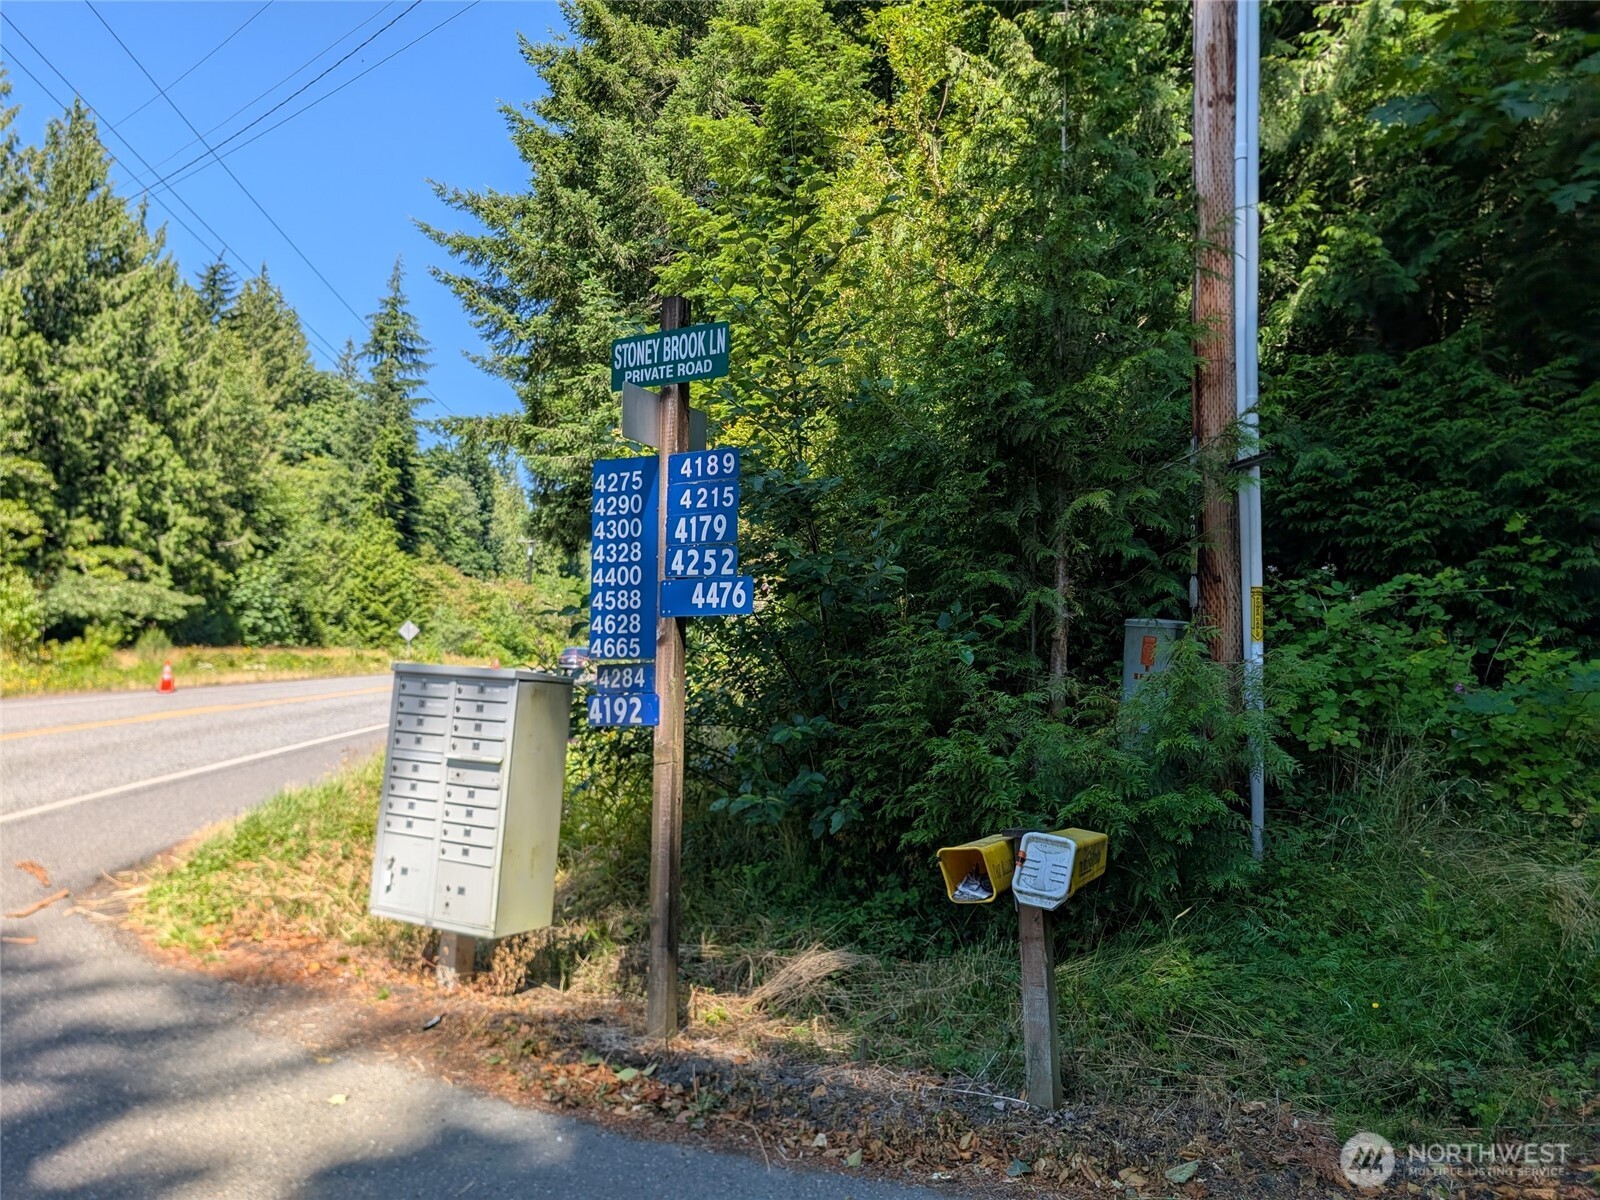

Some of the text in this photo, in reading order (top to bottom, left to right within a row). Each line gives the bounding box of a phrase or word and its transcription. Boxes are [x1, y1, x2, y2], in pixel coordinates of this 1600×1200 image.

[614, 327, 726, 370] STONEY BROOK LN
[625, 359, 713, 383] PRIVATE ROAD
[680, 452, 735, 478] 4189
[594, 470, 643, 493] 4275
[594, 493, 643, 517] 4290
[680, 486, 734, 509] 4215
[593, 517, 642, 540] 4300
[674, 514, 727, 543] 4179
[593, 541, 642, 563] 4328
[671, 548, 734, 576] 4252
[592, 564, 642, 587] 4400
[592, 589, 641, 611] 4588
[691, 581, 746, 609] 4476
[591, 613, 640, 634] 4628
[590, 637, 641, 658] 4665
[599, 667, 645, 688] 4284
[588, 696, 643, 724] 4192
